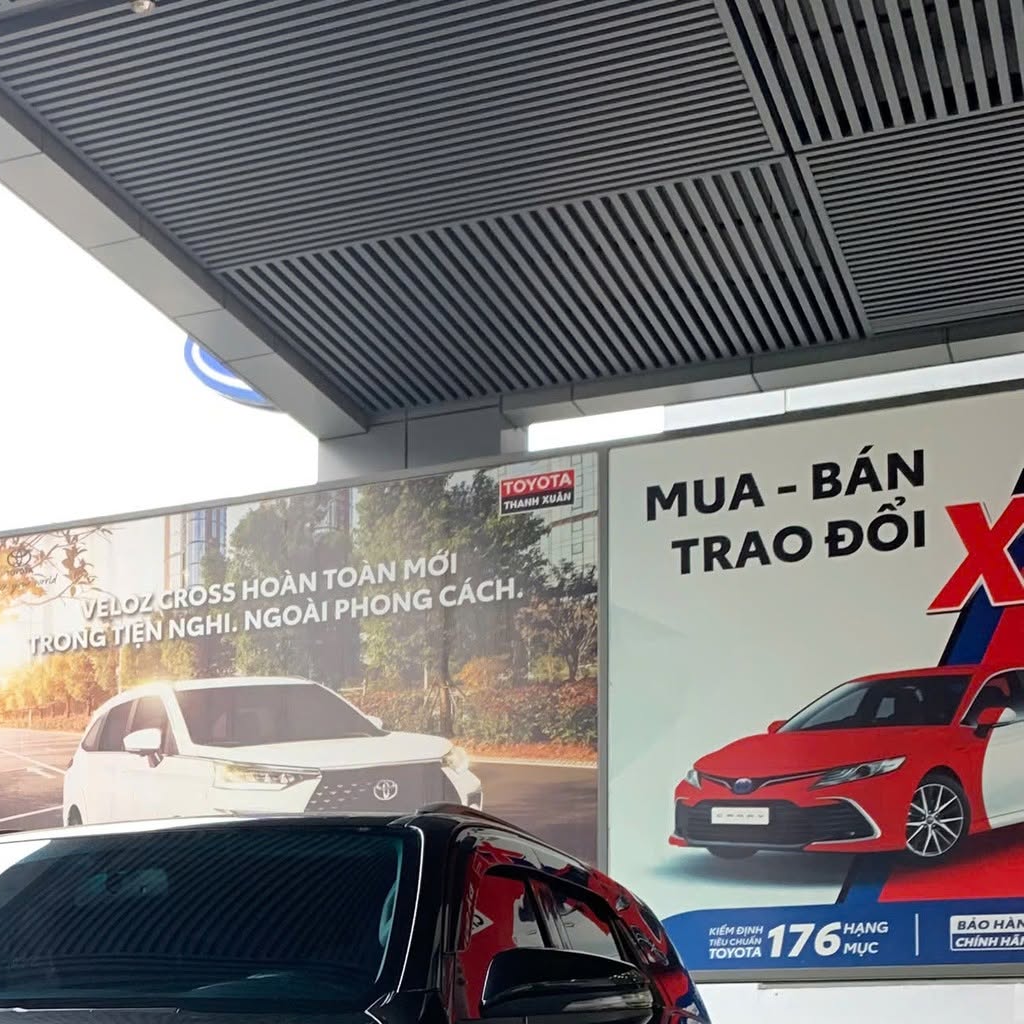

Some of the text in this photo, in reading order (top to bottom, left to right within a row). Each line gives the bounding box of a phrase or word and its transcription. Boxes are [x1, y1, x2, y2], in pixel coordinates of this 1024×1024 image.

[503, 472, 573, 495] TOYOTA
[646, 473, 765, 522] MUA
[812, 445, 925, 500] BÁN
[504, 491, 572, 510] THANH XUÂN
[671, 496, 926, 575] TRAO ĐỔI
[82, 549, 457, 619] VELOZ CROSS HOÀN TOÀN MỚI
[29, 576, 524, 656] TRONG TIỆN NGHI. NGOÀI PHONG CÁCH.
[736, 926, 764, 937] ĐỊNH
[843, 921, 888, 937] HẠNG
[957, 917, 990, 930] BẢO
[709, 937, 728, 946] TIÊU
[768, 921, 842, 958] 176
[955, 934, 999, 947] CHÍNH
[709, 947, 762, 959] TOYOTA
[843, 942, 879, 957] MỤC
